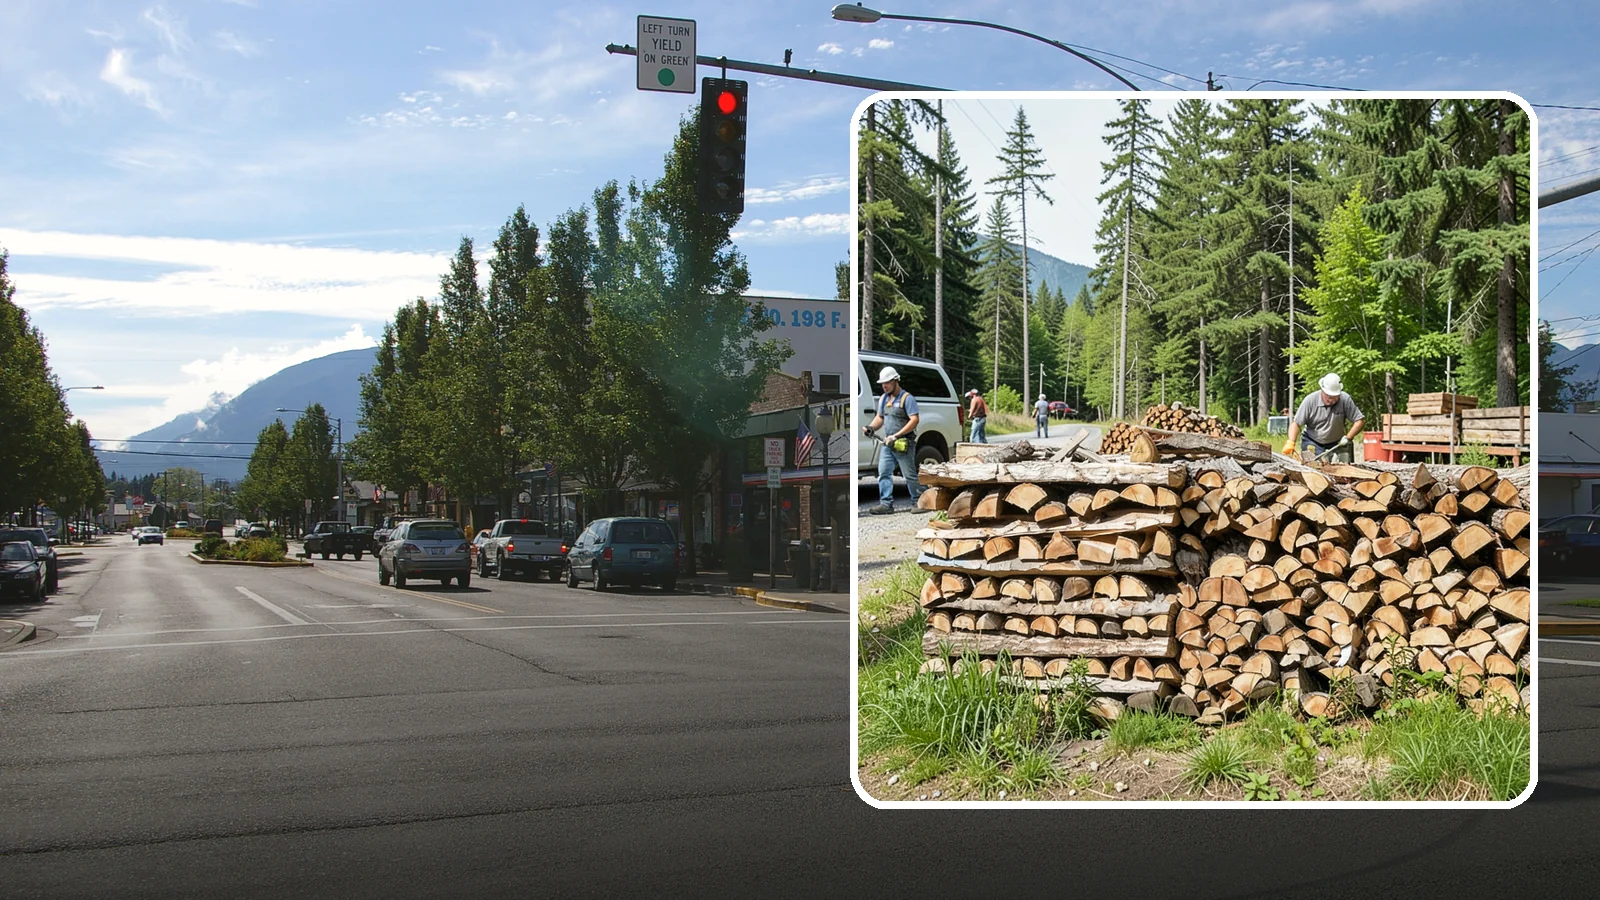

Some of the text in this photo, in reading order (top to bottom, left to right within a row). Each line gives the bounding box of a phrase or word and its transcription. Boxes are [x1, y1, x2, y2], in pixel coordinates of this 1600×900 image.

[643, 24, 690, 36] LEFT TURN
[652, 38, 682, 51] YIELD
[791, 309, 826, 328] 198
[831, 311, 846, 329] F.
